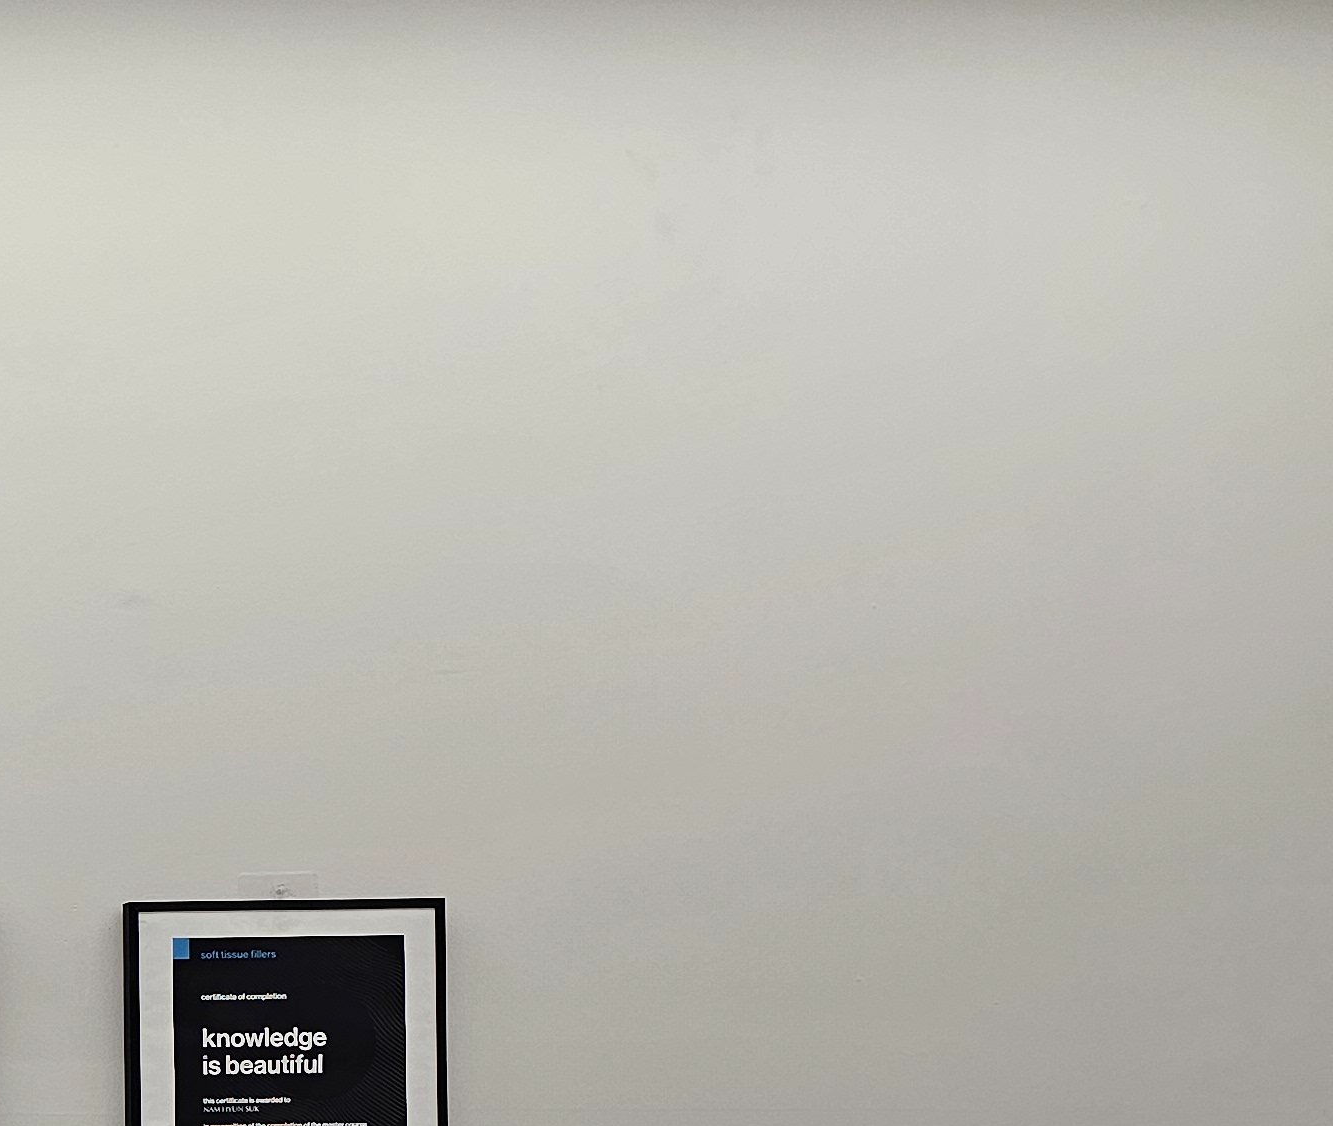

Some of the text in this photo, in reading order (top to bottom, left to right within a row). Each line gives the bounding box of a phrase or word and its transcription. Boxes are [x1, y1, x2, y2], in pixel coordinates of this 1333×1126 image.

[201, 950, 277, 959] soft tissue fillers
[200, 993, 237, 1001] certificate
[246, 992, 288, 1001] completion
[203, 1027, 327, 1051] knowledge
[203, 1054, 323, 1075] is beautiful
